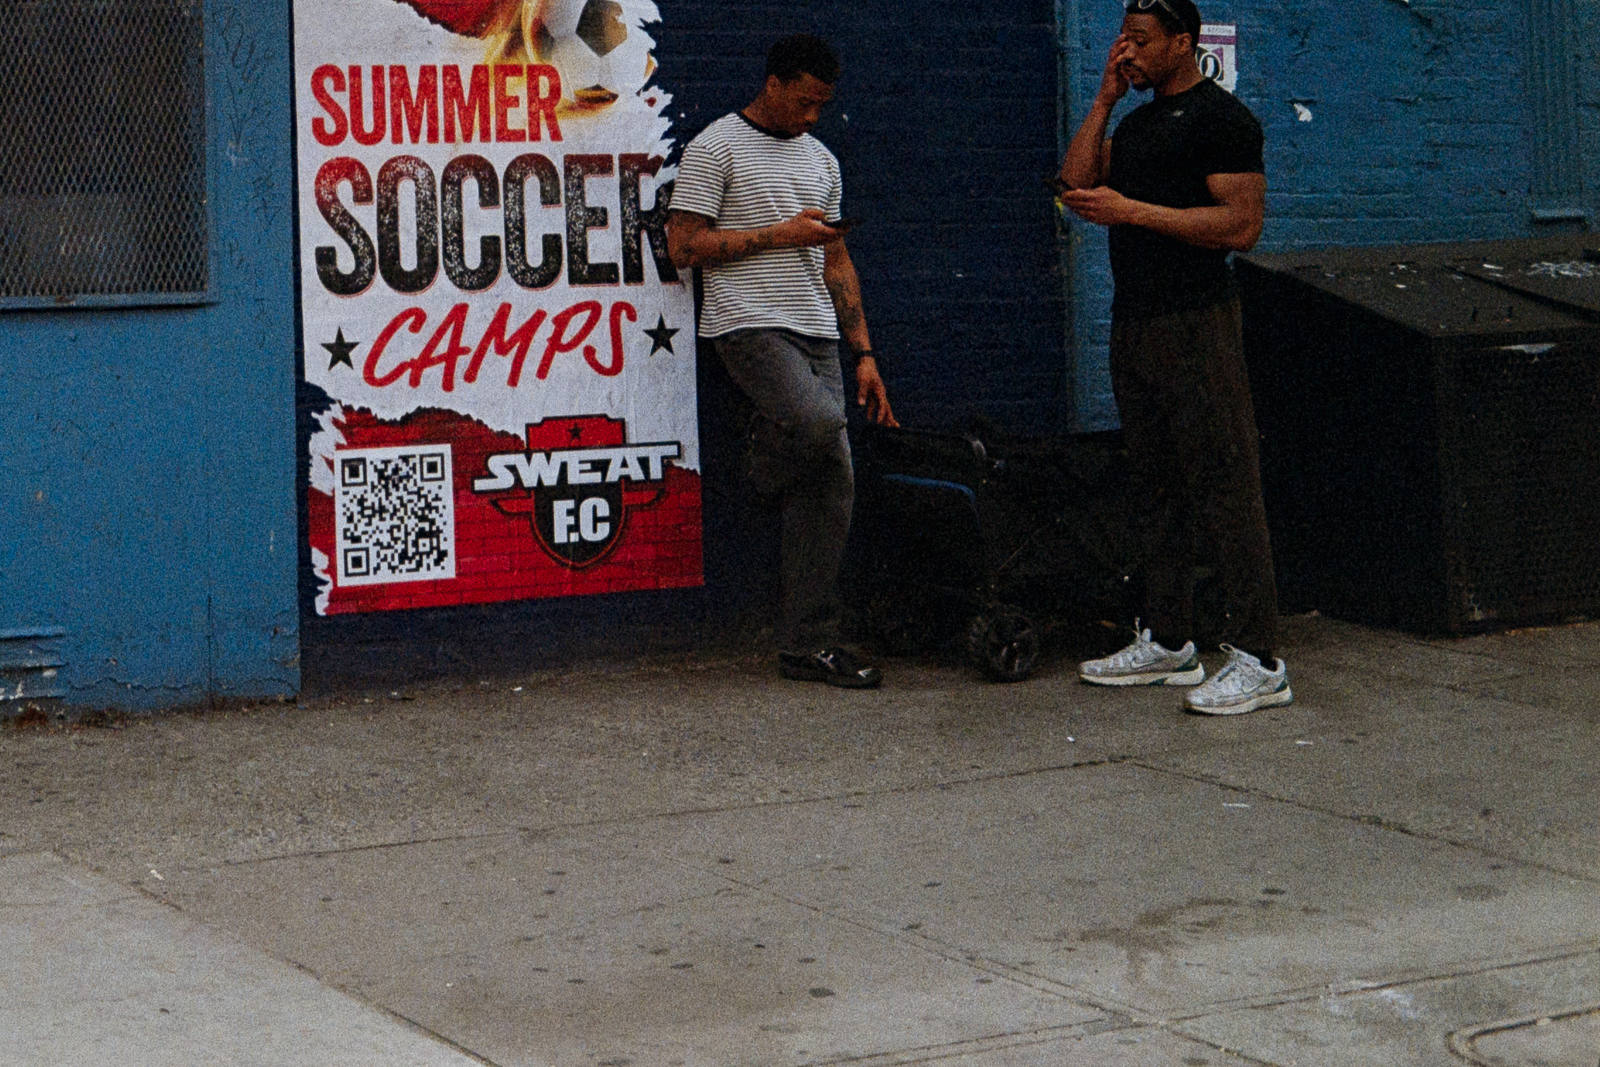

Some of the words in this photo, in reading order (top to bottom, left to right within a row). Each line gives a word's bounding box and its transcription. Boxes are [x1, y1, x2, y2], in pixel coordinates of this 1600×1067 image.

[310, 63, 564, 147] SUMMER
[314, 151, 686, 297] SOCCER
[362, 300, 637, 393] CAMPS
[473, 443, 680, 491] SWEAT
